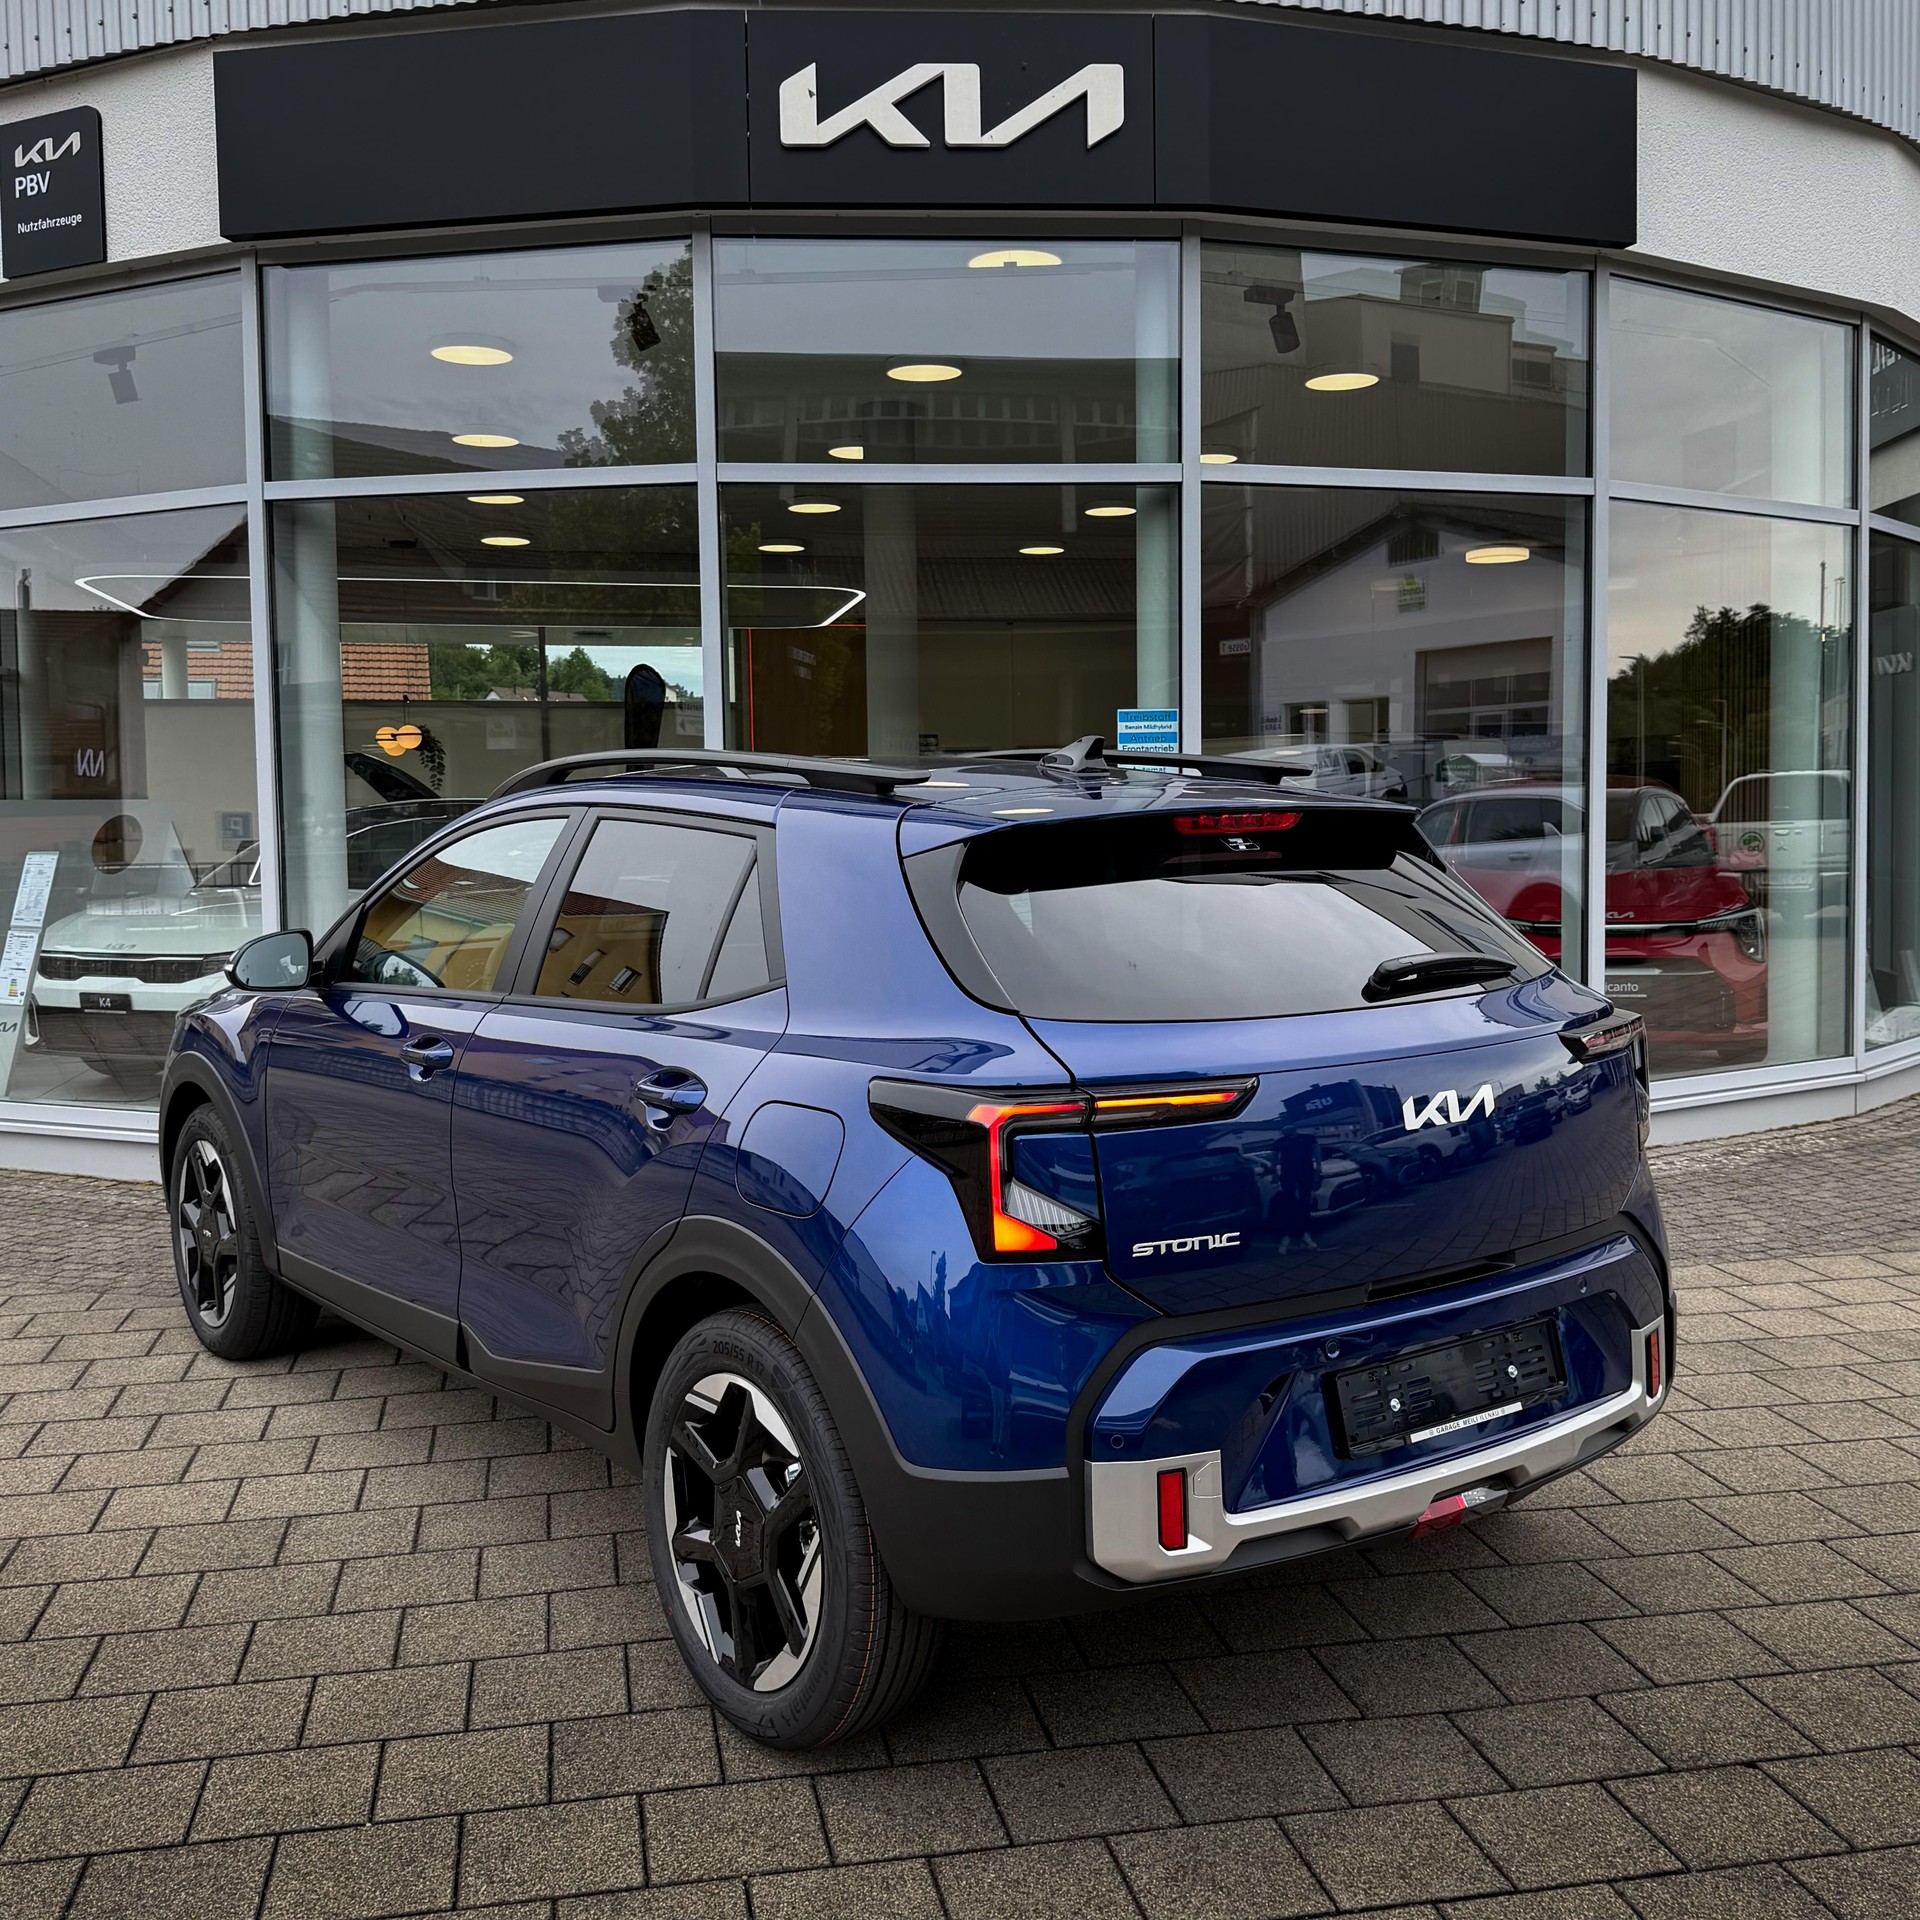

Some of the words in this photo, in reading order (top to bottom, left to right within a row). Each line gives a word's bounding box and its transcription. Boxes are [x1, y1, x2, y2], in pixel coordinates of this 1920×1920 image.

[779, 62, 1124, 148] KIA
[15, 131, 81, 168] KIA
[15, 171, 51, 198] PBV
[17, 214, 82, 234] Nutzfahrzeuge
[1125, 711, 1172, 721] Treibstoff
[1130, 734, 1168, 743] Antrieb
[1122, 744, 1175, 752] Frontantrieb
[1605, 982, 1639, 992] icanto
[98, 997, 112, 1008] K4
[0, 1021, 18, 1033] IA
[1402, 1084, 1495, 1131] KIA
[1132, 1232, 1241, 1257] STONIC
[713, 1340, 745, 1362] 205/55
[1436, 1422, 1460, 1433] GARAGE
